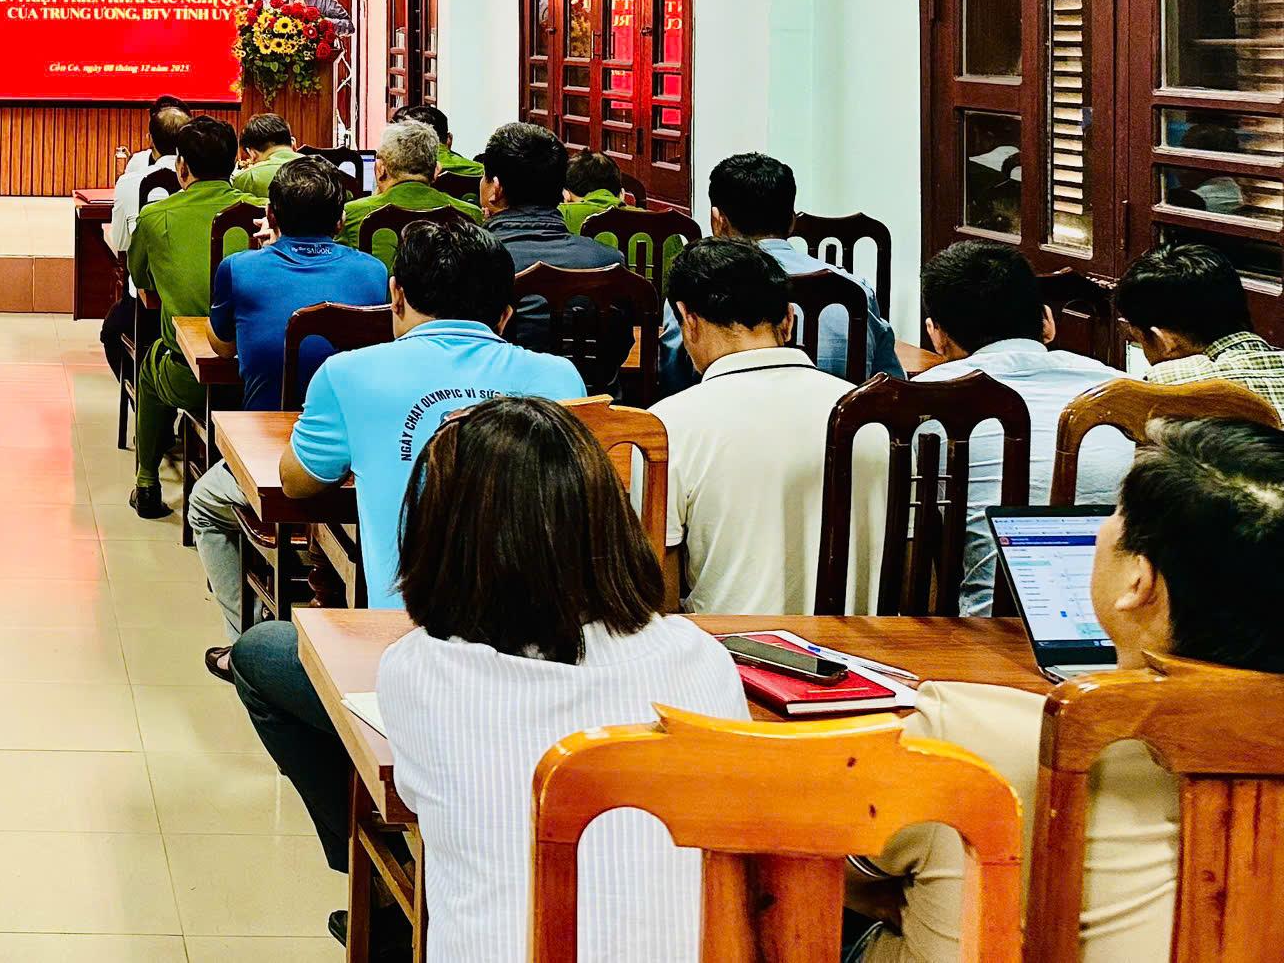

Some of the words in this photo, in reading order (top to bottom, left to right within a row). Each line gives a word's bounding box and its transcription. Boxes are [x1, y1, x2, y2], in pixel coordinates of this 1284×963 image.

[7, 4, 38, 19] CỦA
[40, 7, 91, 19] TRUNG
[143, 8, 171, 20] BTV
[420, 388, 463, 408] OLYMPIC
[466, 387, 476, 398] VÌ
[404, 404, 425, 431] CHẠY
[399, 431, 413, 461] NGÀY
